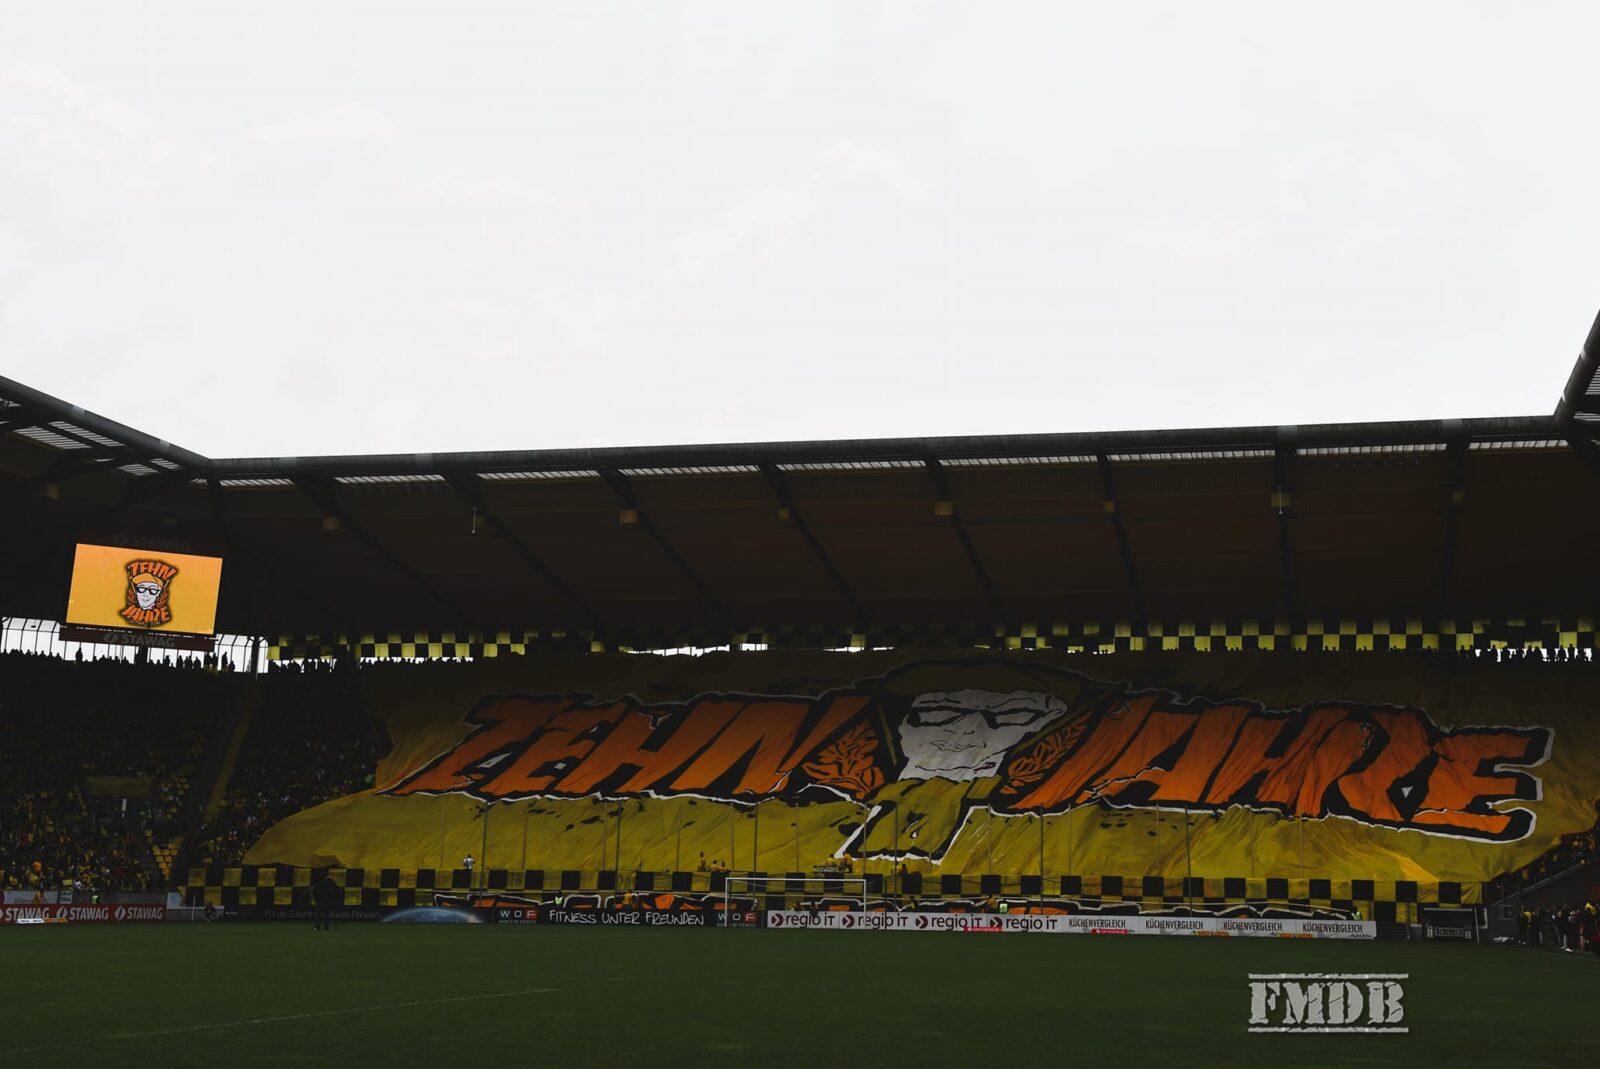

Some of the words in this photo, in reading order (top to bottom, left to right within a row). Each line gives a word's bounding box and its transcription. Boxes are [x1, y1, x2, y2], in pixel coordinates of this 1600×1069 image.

[121, 634, 176, 647] STAWAG
[388, 693, 874, 798] ZEHN
[1004, 694, 1542, 838] JAHRE
[5, 907, 50, 921] STAWAG
[69, 907, 109, 920] STAWAG
[127, 907, 163, 920] STAWAG
[549, 909, 597, 924] FITNESS
[601, 912, 641, 925] UNTER
[645, 911, 704, 926] FREUNDEN
[858, 912, 894, 929] regio
[785, 913, 821, 929] regio
[931, 914, 968, 931] regio
[1006, 915, 1043, 932] regio
[1068, 917, 1126, 928] KÜCHENVERGLEICH
[1145, 918, 1204, 930] KÜCHENVERGLEICH
[1223, 920, 1283, 931] KÜCHENVERGLEICH
[1302, 921, 1363, 933] KÜCHENVERGLEICH
